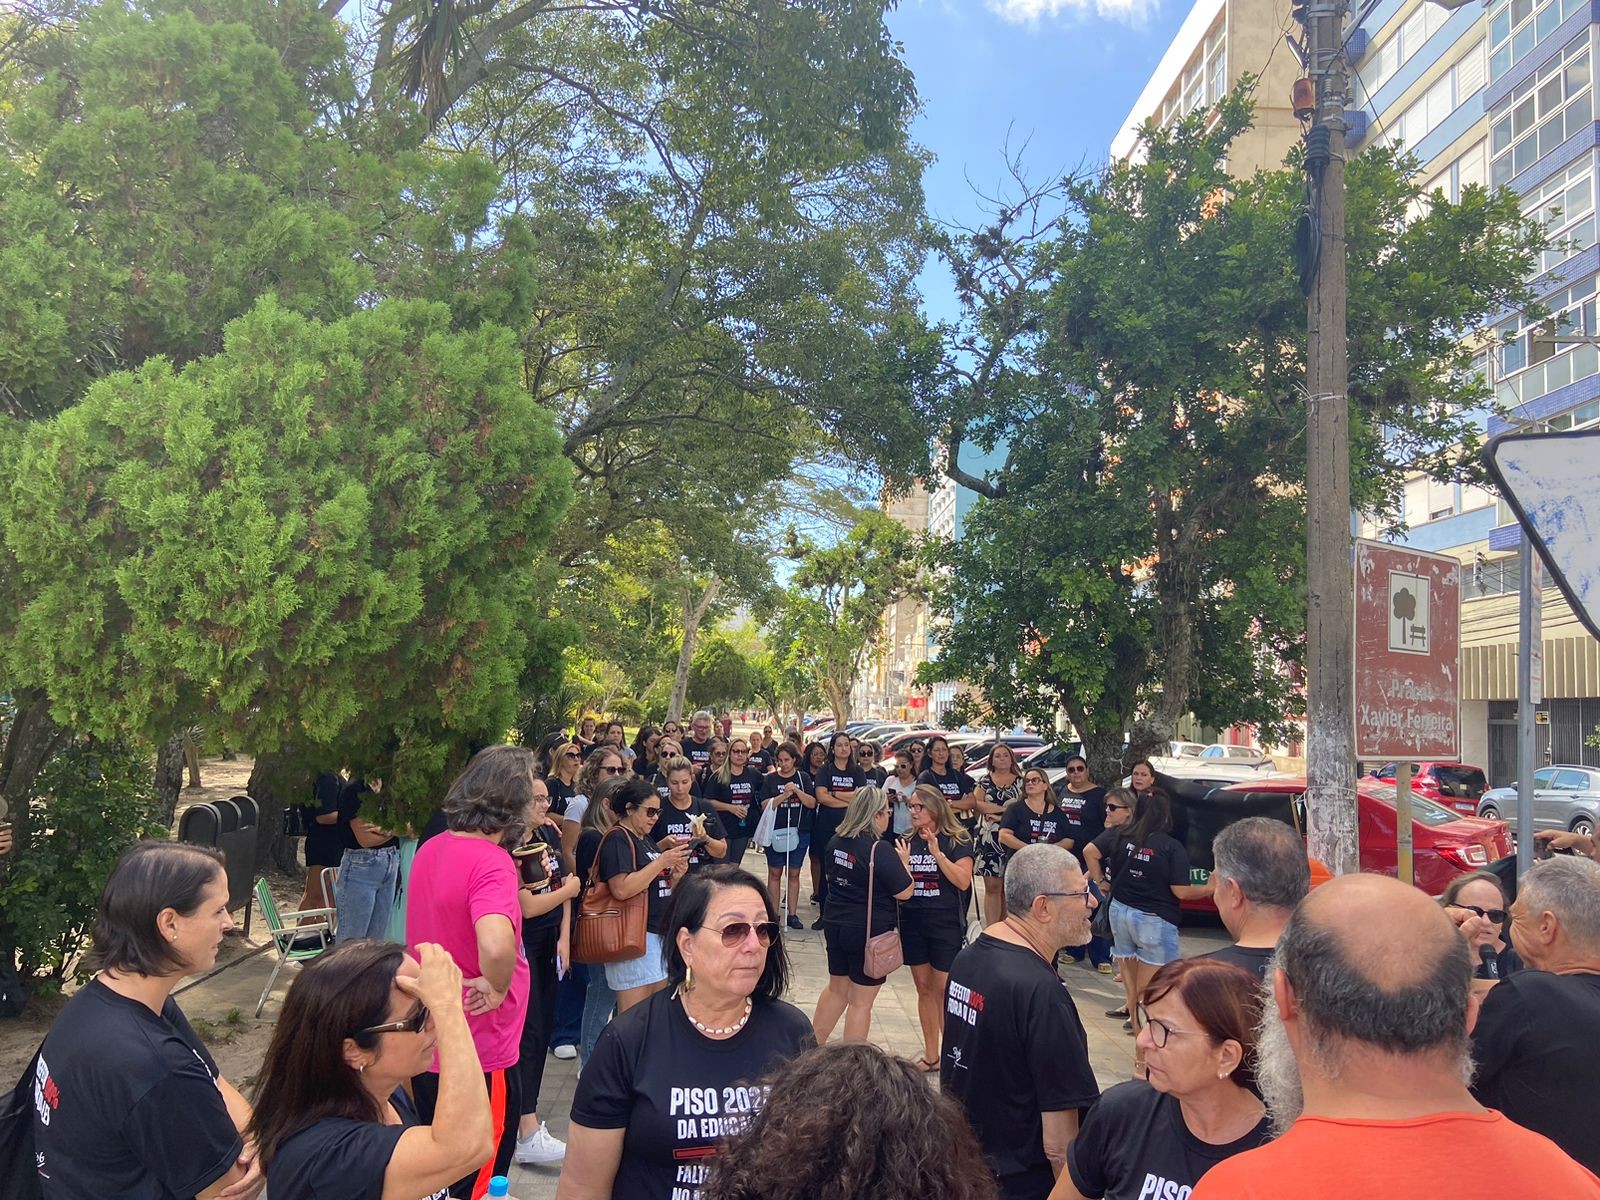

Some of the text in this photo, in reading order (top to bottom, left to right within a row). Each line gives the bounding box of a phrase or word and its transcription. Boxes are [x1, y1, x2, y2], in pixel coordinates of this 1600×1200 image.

[1360, 704, 1453, 731] Xavier Ferreira
[668, 824, 684, 834] PISO
[947, 997, 963, 1018] FORA
[968, 1008, 977, 1027] LEI
[670, 1087, 719, 1116] PISO
[677, 1119, 698, 1140] DA
